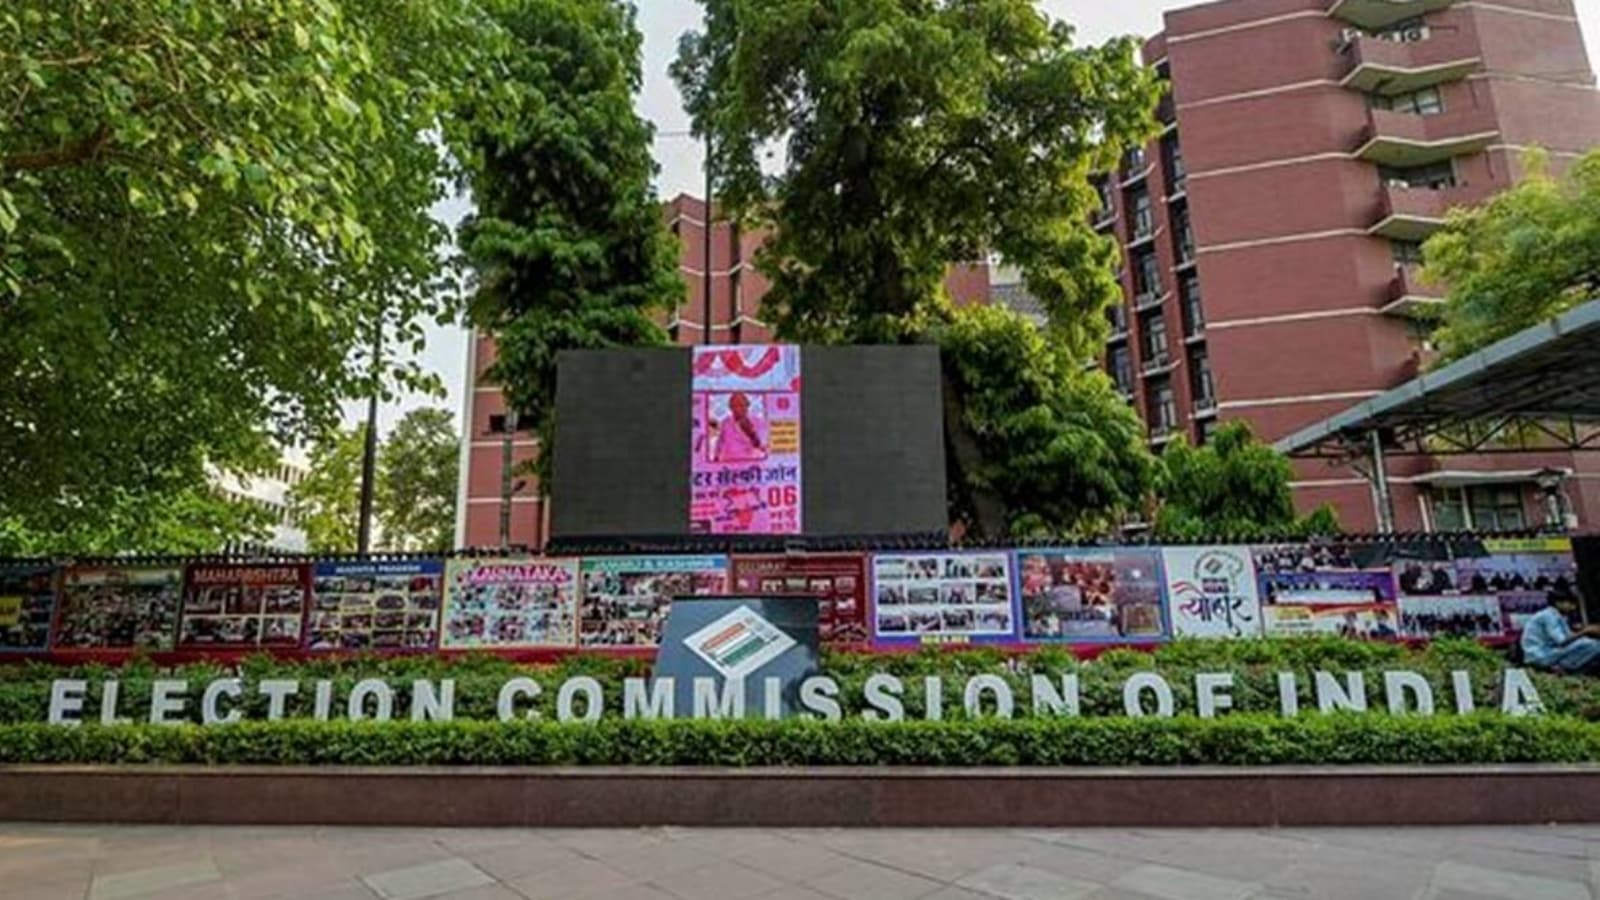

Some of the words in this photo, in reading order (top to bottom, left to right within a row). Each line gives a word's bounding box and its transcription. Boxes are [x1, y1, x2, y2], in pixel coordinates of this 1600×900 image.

[768, 486, 797, 507] 06
[193, 567, 299, 583] MAHARASHTRA
[471, 565, 568, 583] KARNATAKA
[48, 676, 455, 726] ELECTION
[497, 671, 1081, 723] COMMISSION
[1123, 672, 1233, 720] OF
[1278, 667, 1548, 717] INDIA
